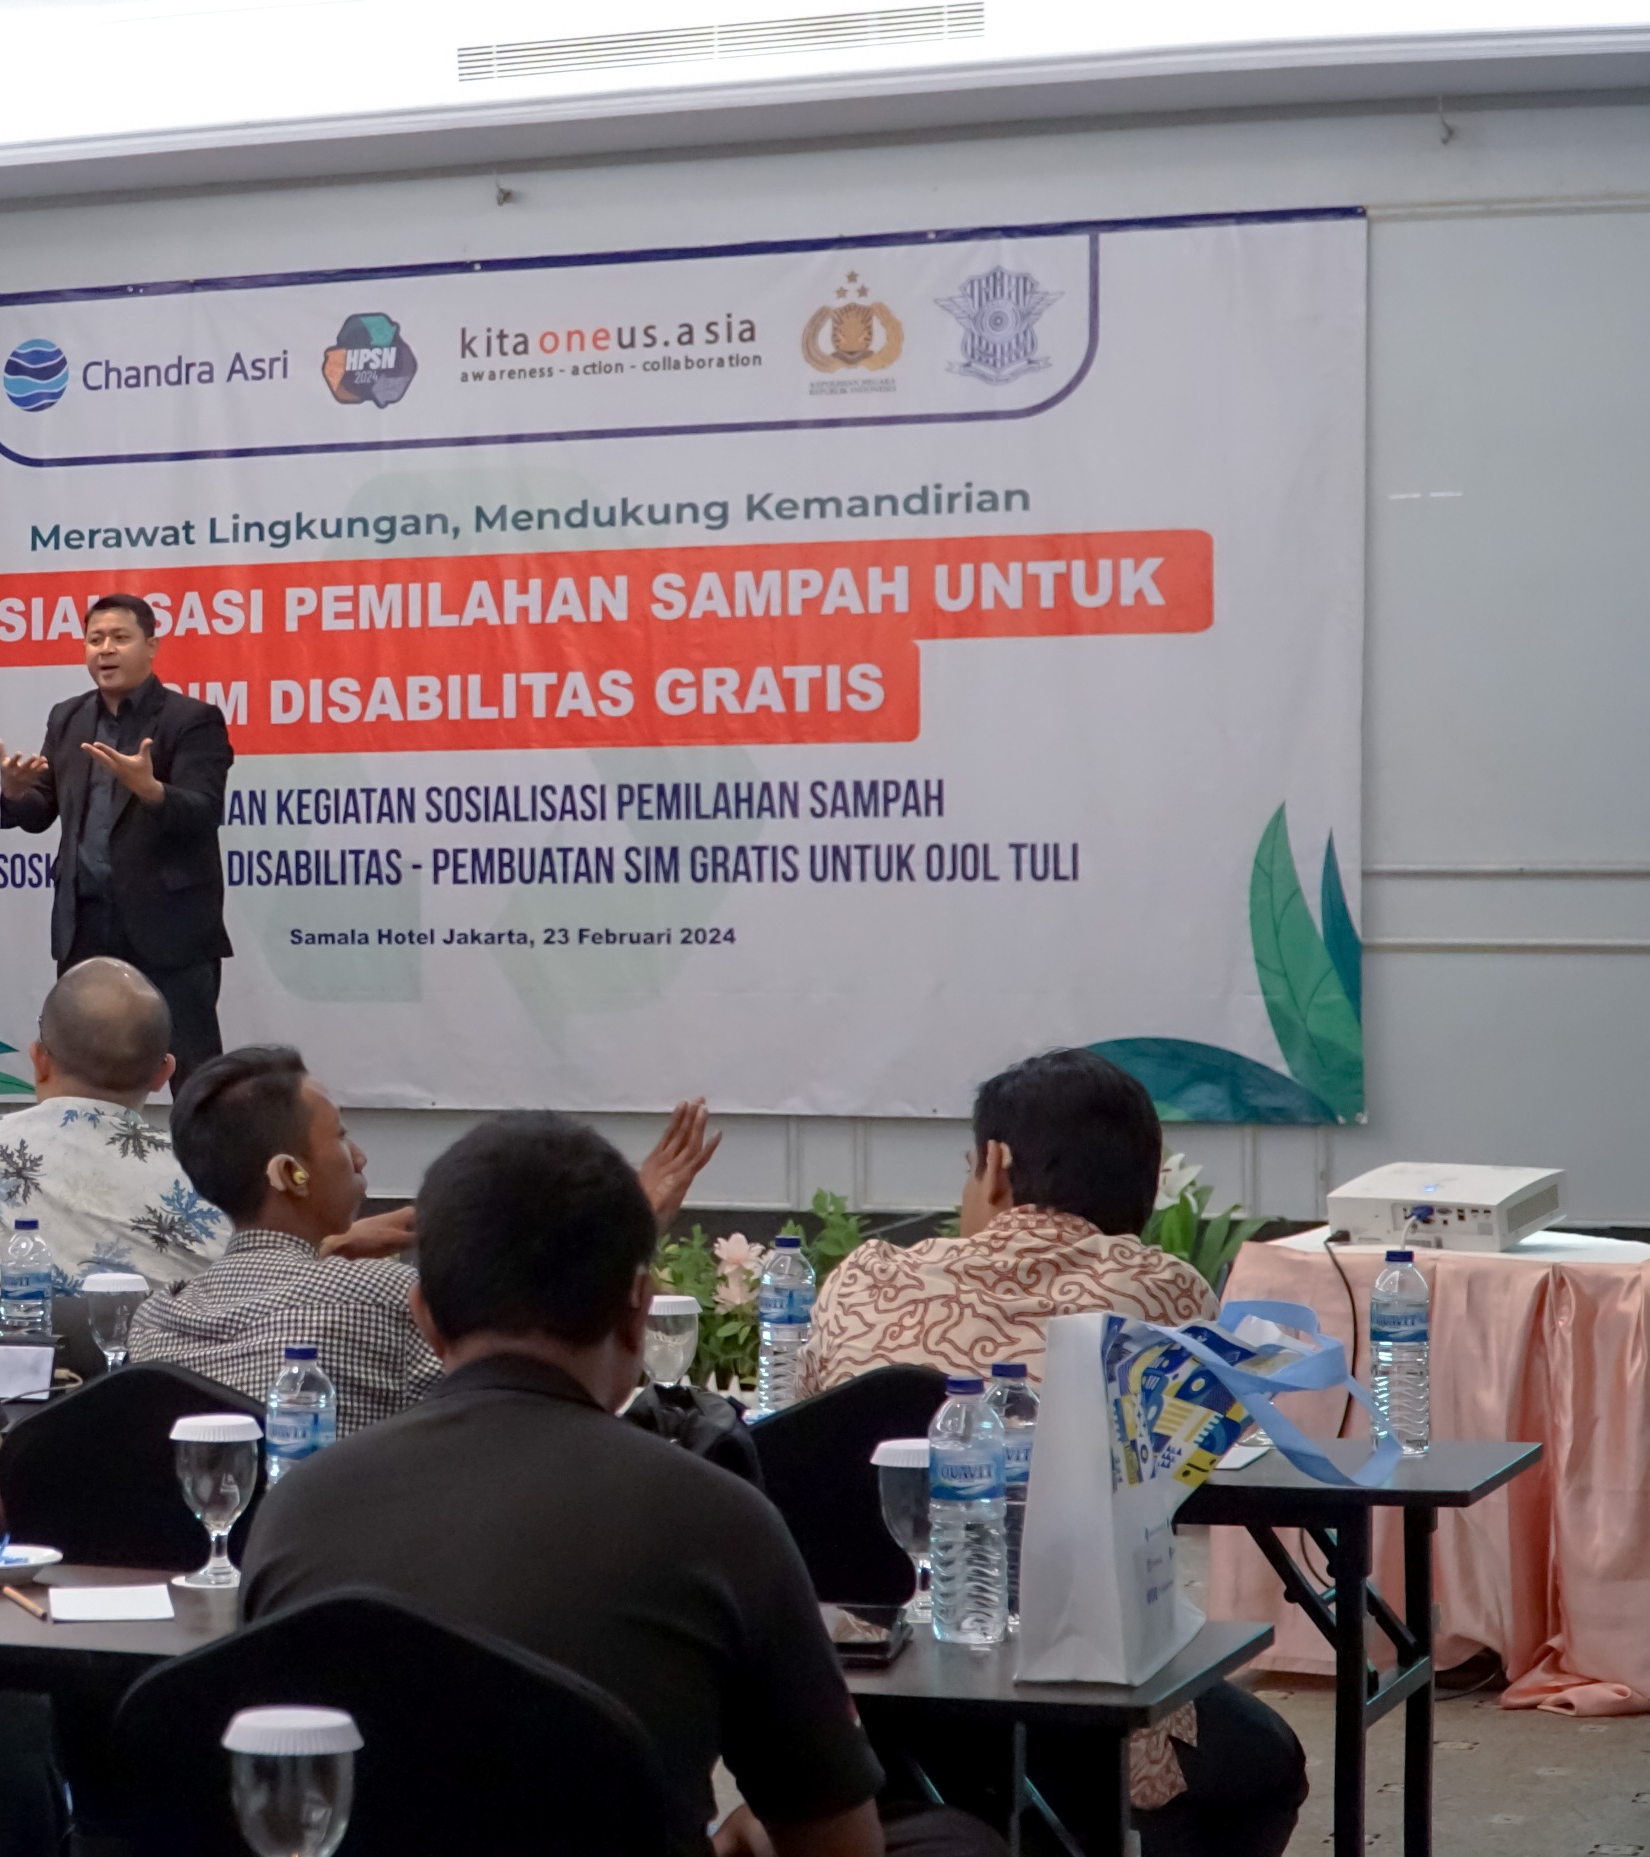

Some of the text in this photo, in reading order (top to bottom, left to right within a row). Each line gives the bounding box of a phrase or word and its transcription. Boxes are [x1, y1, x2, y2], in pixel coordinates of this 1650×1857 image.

[83, 350, 288, 391] Chandra Asri
[345, 346, 397, 372] HPSN
[353, 370, 378, 385] 2024
[461, 367, 553, 382] awareness
[571, 361, 624, 376] action
[642, 353, 762, 372] collaboration
[31, 482, 1030, 551] Merawat Lingkungan, Mendukung Kemandirian
[286, 576, 628, 632] PEMILAHAN
[651, 566, 908, 620] SAMPAH
[935, 557, 1165, 611] UNTUK
[271, 670, 634, 724] DISABILITAS
[655, 663, 884, 715] GRATIS
[277, 788, 415, 825] KEGIATAN
[426, 784, 606, 823] SOSIALISASI
[618, 782, 798, 820] PEMILAHAN
[810, 779, 944, 818] SAMPAH
[228, 849, 402, 886] DISABILITAS
[433, 847, 613, 884] PEMBUATAN
[625, 846, 679, 884] SIM
[690, 845, 799, 883] GRATIS
[810, 844, 915, 882] UNTUK
[926, 843, 1000, 882] OJOL
[1009, 843, 1078, 881] TULI
[290, 928, 736, 948] Samala Hotel Jakarta, 23 Februari 2024
